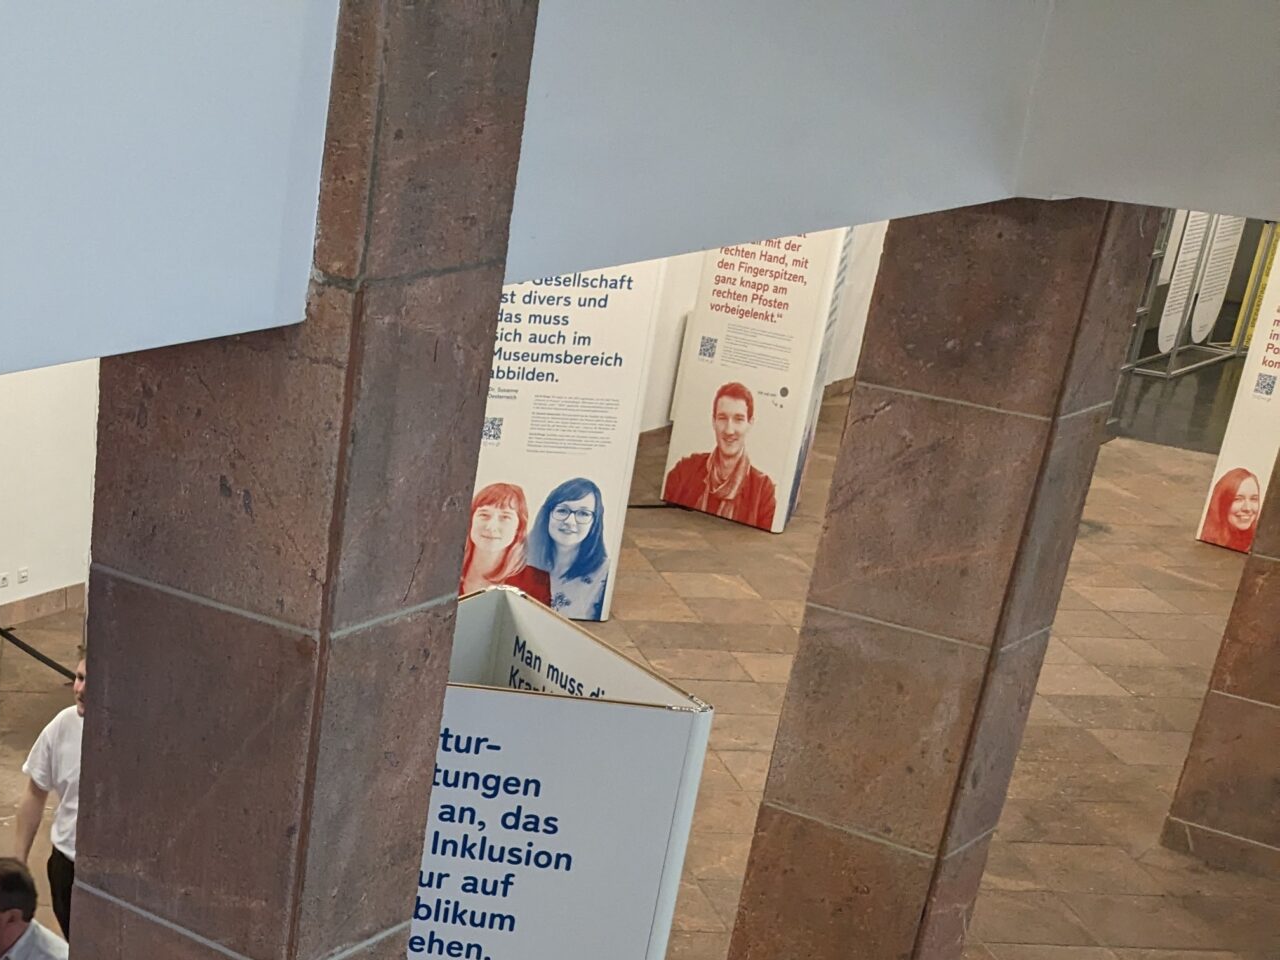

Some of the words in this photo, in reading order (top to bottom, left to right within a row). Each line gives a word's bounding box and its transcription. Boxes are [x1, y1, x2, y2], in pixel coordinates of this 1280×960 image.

[720, 246, 756, 259] rechten
[759, 250, 789, 267] Hand,
[792, 257, 809, 269] mit
[765, 240, 781, 249] mit
[784, 240, 802, 252] der
[717, 259, 735, 271] den
[738, 261, 807, 286] Fingerspitzen,
[714, 274, 737, 286] ganz
[740, 277, 769, 293] knapp
[772, 286, 788, 295] am
[522, 291, 572, 306] divers
[577, 294, 609, 308] und
[712, 288, 748, 302] rechten
[751, 293, 789, 310] Pfosten
[528, 313, 570, 326] muss
[528, 330, 566, 344] auch
[572, 332, 592, 346] im
[493, 347, 623, 367] Museumsbereich
[490, 366, 559, 383] abbilden.
[513, 635, 542, 673] Man
[546, 663, 584, 696] muss
[440, 727, 501, 755] tur-
[433, 763, 541, 798] tungen
[438, 803, 487, 832] an,
[500, 805, 559, 836] das
[430, 830, 574, 872] Inklusion
[418, 869, 450, 889] ur
[460, 872, 515, 898] auf
[413, 896, 516, 932] blikum
